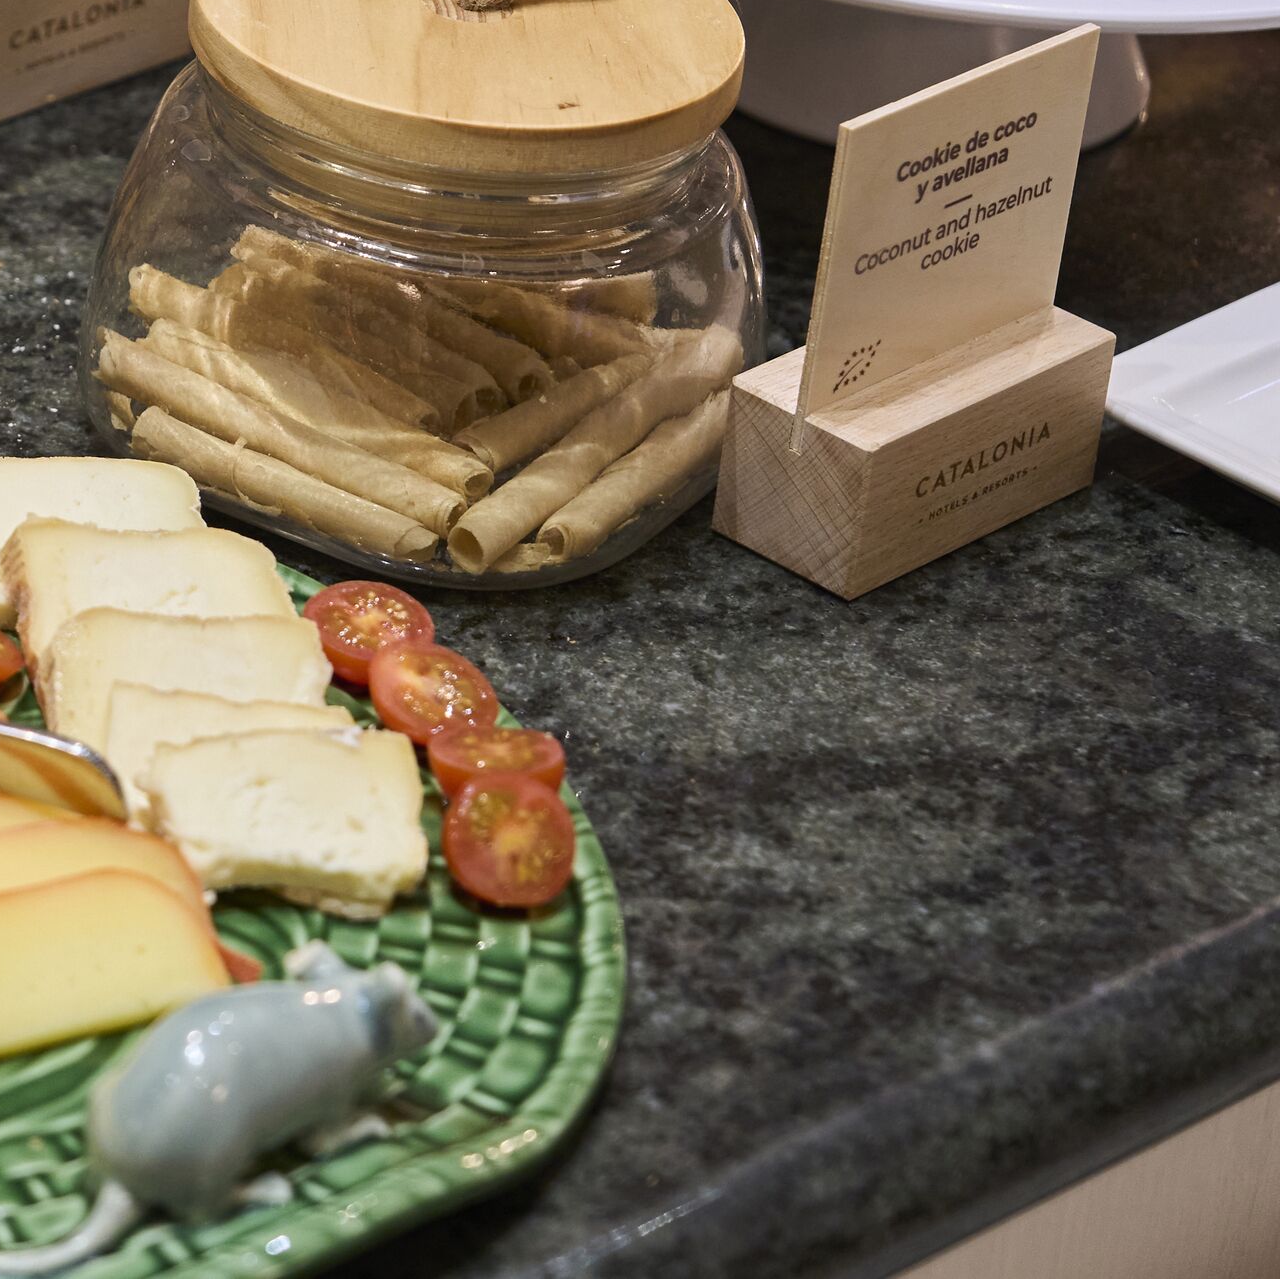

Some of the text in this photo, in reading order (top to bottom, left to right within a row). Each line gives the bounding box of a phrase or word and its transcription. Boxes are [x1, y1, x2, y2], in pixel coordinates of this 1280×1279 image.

[896, 111, 1038, 183] Cookie de coco
[914, 146, 1010, 204] y avellana
[854, 175, 1053, 276] Coconut and hazelnut
[920, 231, 981, 270] cookie
[915, 422, 1051, 499] CATALONIA
[928, 495, 969, 522] HOTELS
[982, 469, 1029, 497] RESORTS
